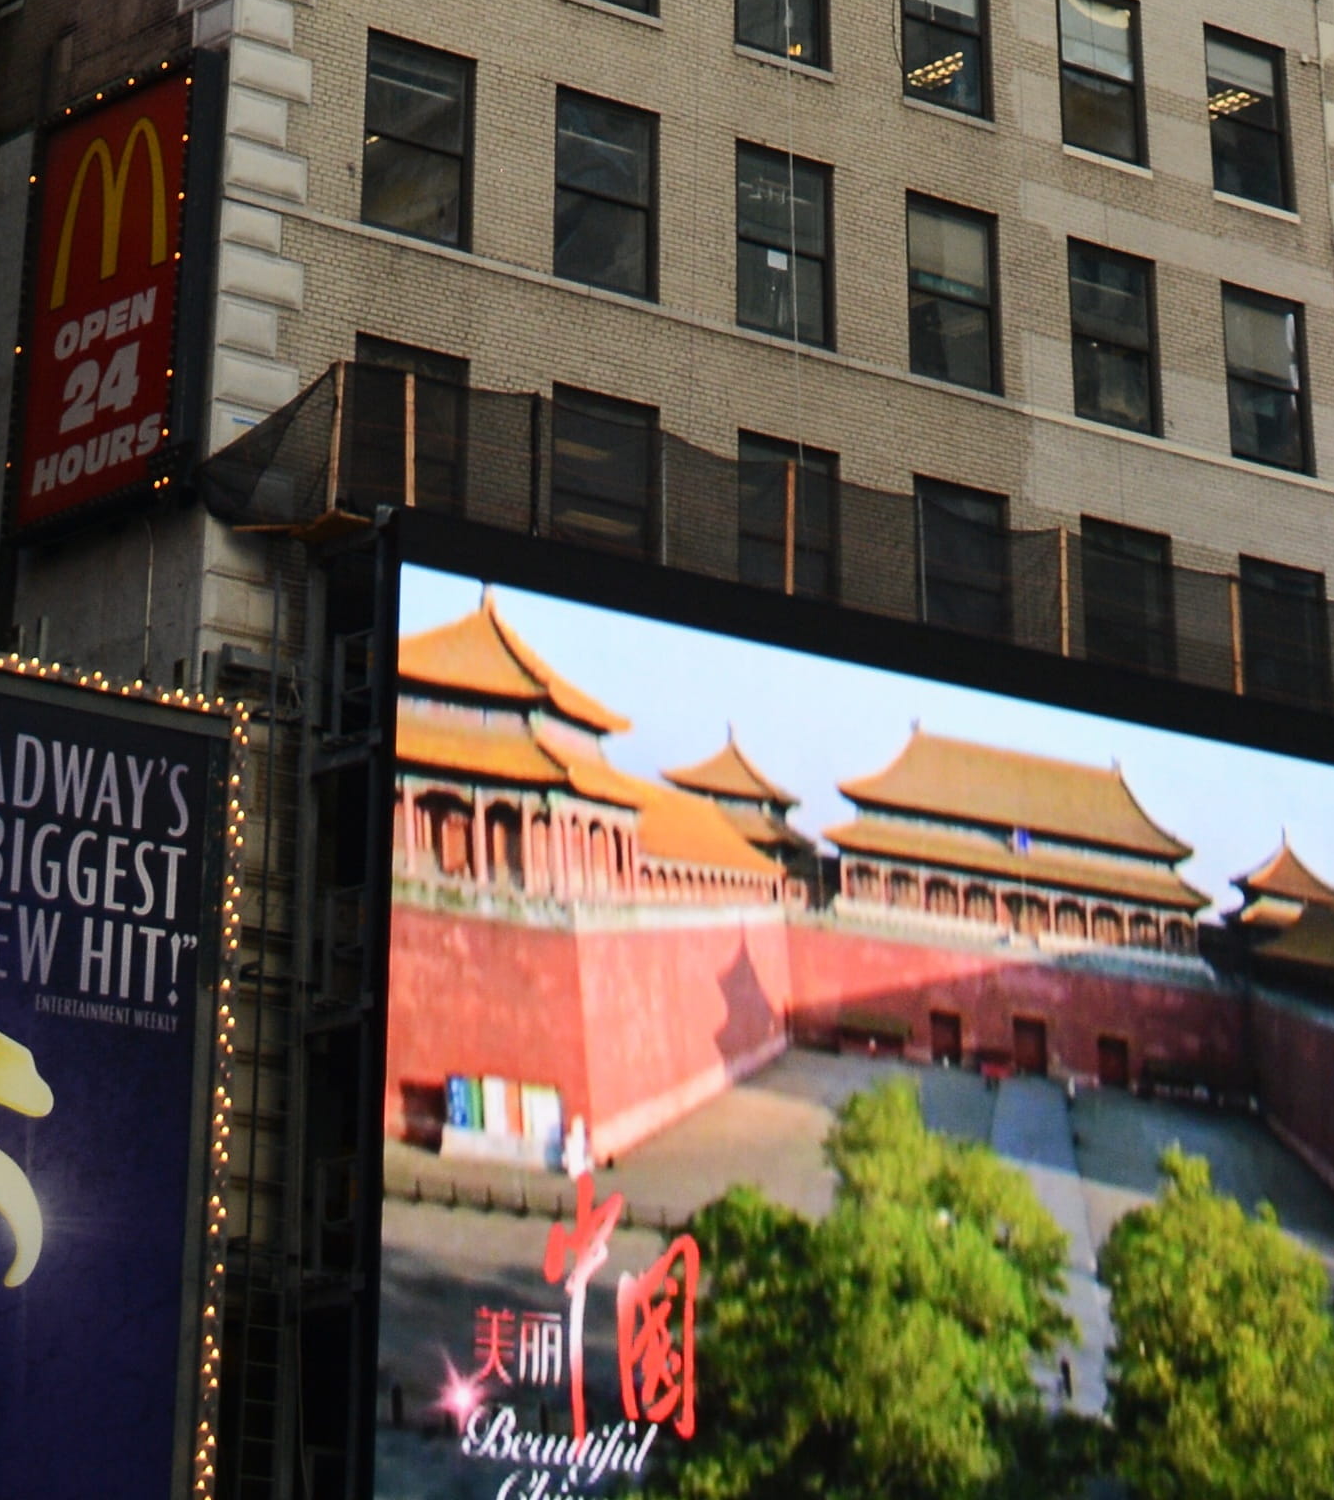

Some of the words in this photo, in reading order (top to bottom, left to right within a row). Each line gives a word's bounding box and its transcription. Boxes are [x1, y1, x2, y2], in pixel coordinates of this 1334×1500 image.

[54, 285, 158, 362] OPEN
[59, 341, 141, 435] 24
[30, 413, 162, 497] HOURS
[79, 915, 198, 1007] HIT!”
[35, 993, 130, 1026] ENTERTAINMENT
[134, 1008, 179, 1033] WEEKLY
[473, 1304, 563, 1388] 美丽
